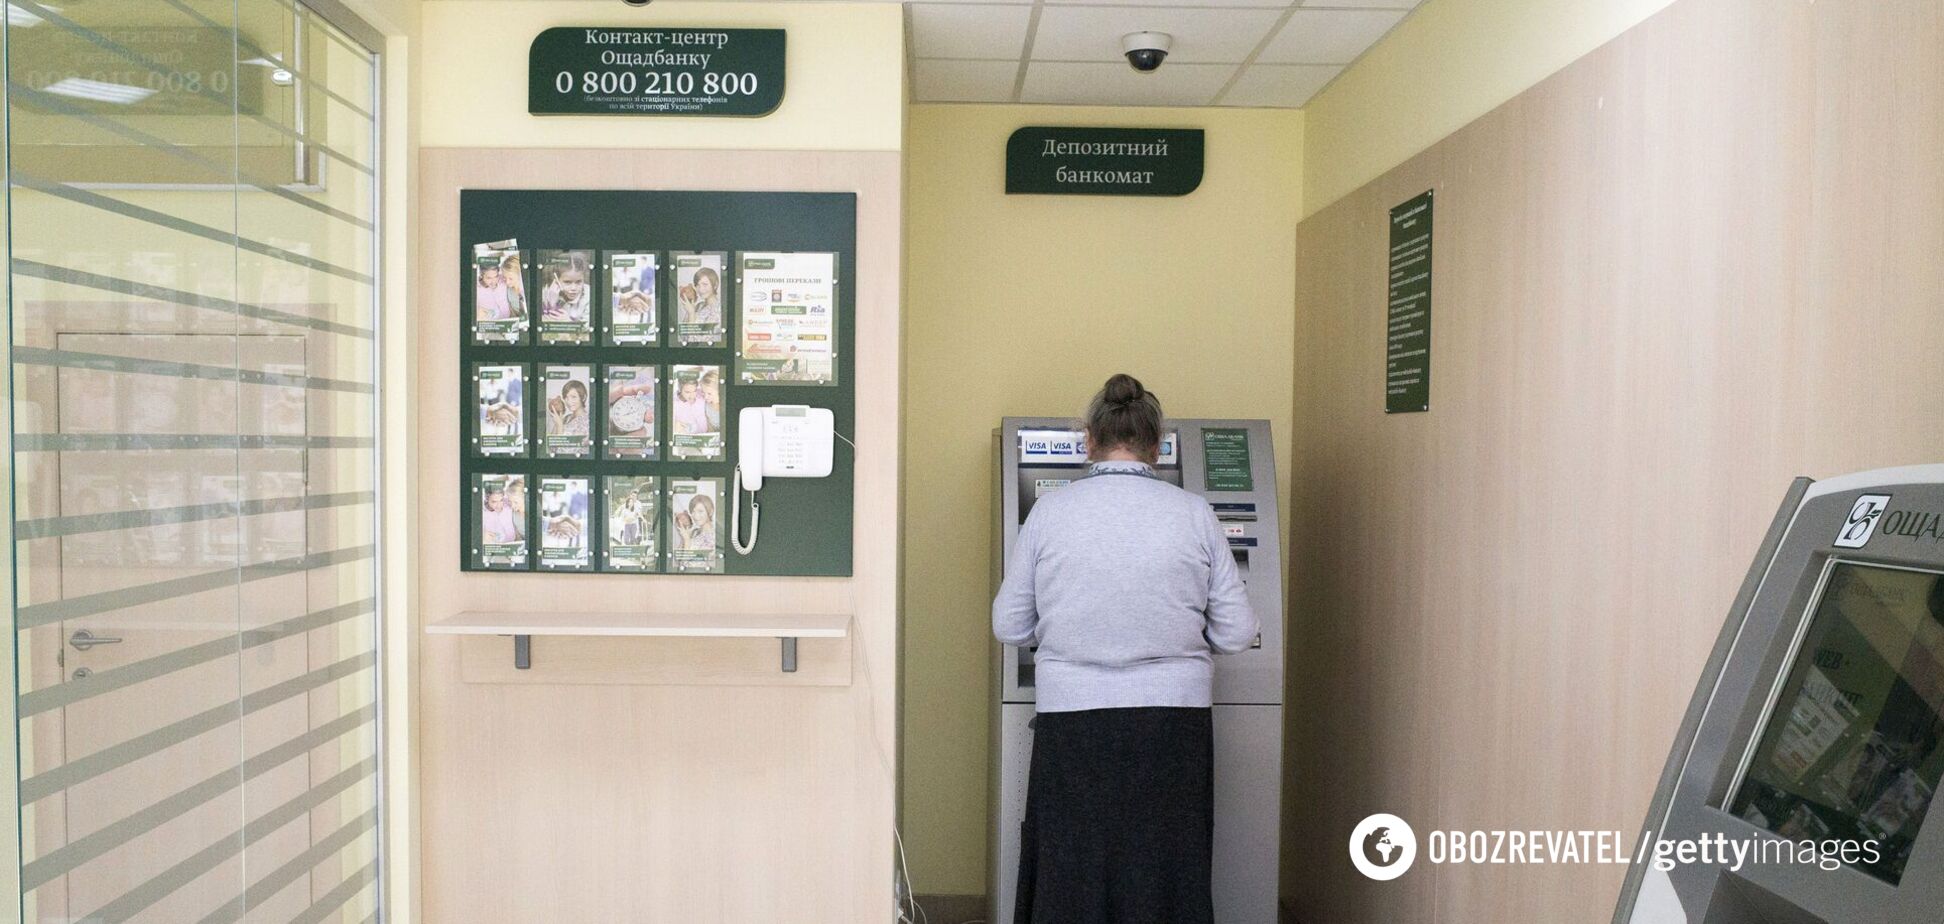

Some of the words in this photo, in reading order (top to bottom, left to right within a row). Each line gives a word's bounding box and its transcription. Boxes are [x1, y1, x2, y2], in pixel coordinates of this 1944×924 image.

[585, 29, 729, 50] Контакт-центр
[601, 48, 711, 69] Ощадбанку
[555, 71, 574, 94] 0
[582, 71, 637, 94] 800
[644, 71, 694, 95] 210
[702, 72, 758, 96] 800
[1041, 139, 1168, 158] Депозитний
[1055, 165, 1154, 184] банкомат
[1029, 442, 1047, 450] VISA
[1053, 442, 1072, 450] VISA
[1883, 510, 1944, 544] ОЩА
